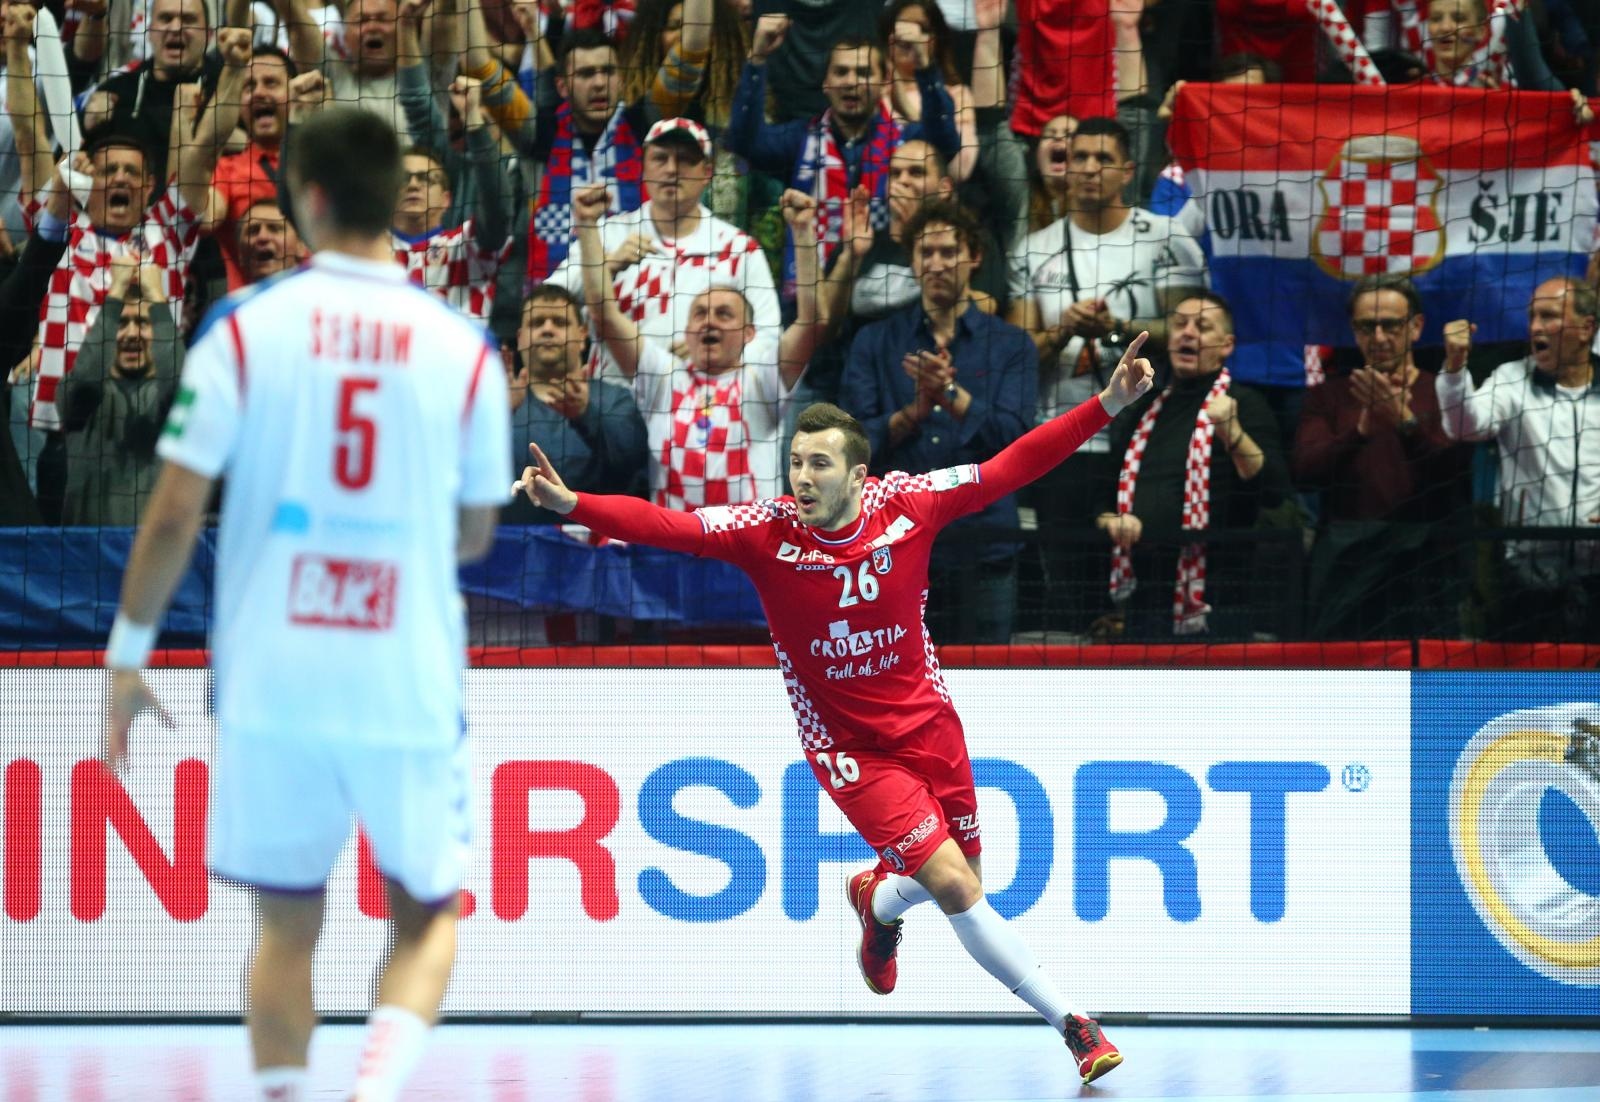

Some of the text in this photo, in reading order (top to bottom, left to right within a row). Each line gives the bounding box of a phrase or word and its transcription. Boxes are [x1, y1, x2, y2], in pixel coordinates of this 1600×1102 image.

[1213, 180, 1562, 242] ORA ŠJE
[332, 377, 379, 491] 5
[800, 549, 835, 564] HPB
[833, 560, 880, 608] 26
[810, 623, 907, 659] CROATIA
[816, 751, 860, 789] 26
[6, 757, 1331, 922] INRSPORT
[896, 813, 939, 852] PORSCH
